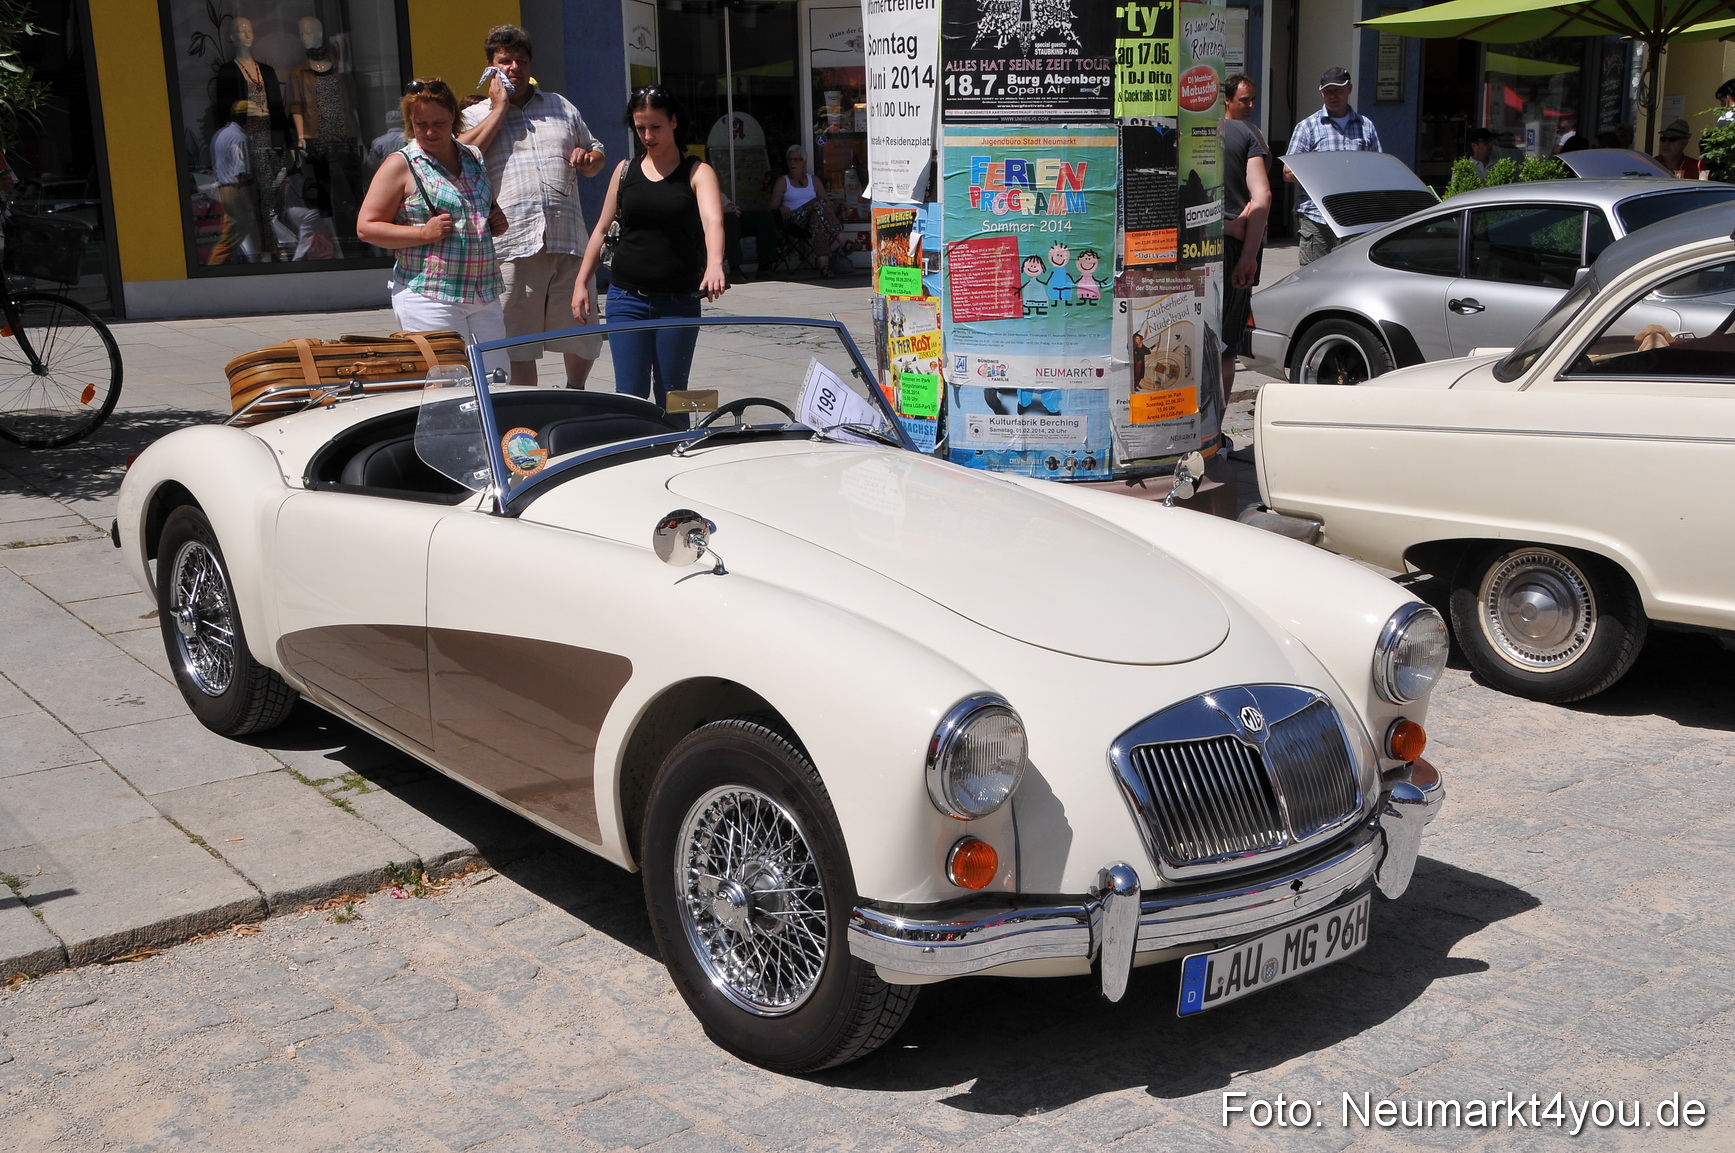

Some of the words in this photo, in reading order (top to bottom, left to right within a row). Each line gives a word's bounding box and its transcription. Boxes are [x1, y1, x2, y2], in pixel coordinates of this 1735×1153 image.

[868, 32, 917, 60] Sonntag
[1034, 48, 1064, 56] STAUBKIND
[1068, 48, 1079, 56] FAQ
[1138, 43, 1172, 65] 17.05.
[945, 59, 977, 72] ALLES
[980, 59, 1006, 72] HAT
[1009, 58, 1042, 71] SEINE
[1045, 59, 1070, 71] ZEIT
[1076, 59, 1111, 71] TOUR
[891, 65, 935, 90] 2014
[944, 74, 1005, 96] 18.7.
[1007, 74, 1040, 87] Burg
[1044, 74, 1111, 87] Abenberg
[1128, 71, 1145, 85] DJ
[1148, 71, 1172, 85] Dito
[1007, 85, 1045, 96] Open
[1047, 85, 1066, 94] Air
[1117, 92, 1123, 103] &
[1124, 89, 1153, 103] Cocktails
[1155, 89, 1167, 102] 4.50
[1167, 89, 1172, 102] €
[898, 101, 921, 118] Uhr
[981, 138, 1021, 146] Jugendbüro
[970, 155, 1088, 192] FERIEN
[968, 185, 1087, 216] PROGRAMM
[981, 220, 1034, 233] Sommer
[1039, 220, 1073, 233] 2014
[1182, 243, 1201, 259] 30.
[1201, 240, 1217, 257] Mai
[1119, 300, 1128, 315] S
[1145, 293, 1188, 320] Zauberhexe
[1148, 305, 1190, 334] Nudeltraud
[891, 339, 912, 355] RTTER
[918, 350, 937, 360] ZIRKUS
[1035, 367, 1093, 377] NEUMARKT
[816, 387, 837, 417] 199
[1166, 410, 1184, 418] LGS-Park
[900, 420, 937, 437] BACHSE
[989, 418, 1038, 427] Kulturfabrik
[1040, 418, 1079, 428] Berching
[1243, 708, 1261, 729] MG
[1203, 942, 1264, 1003] LAU
[1281, 923, 1319, 975] MG
[1325, 900, 1369, 959] 96H
[1187, 990, 1197, 1004] D
